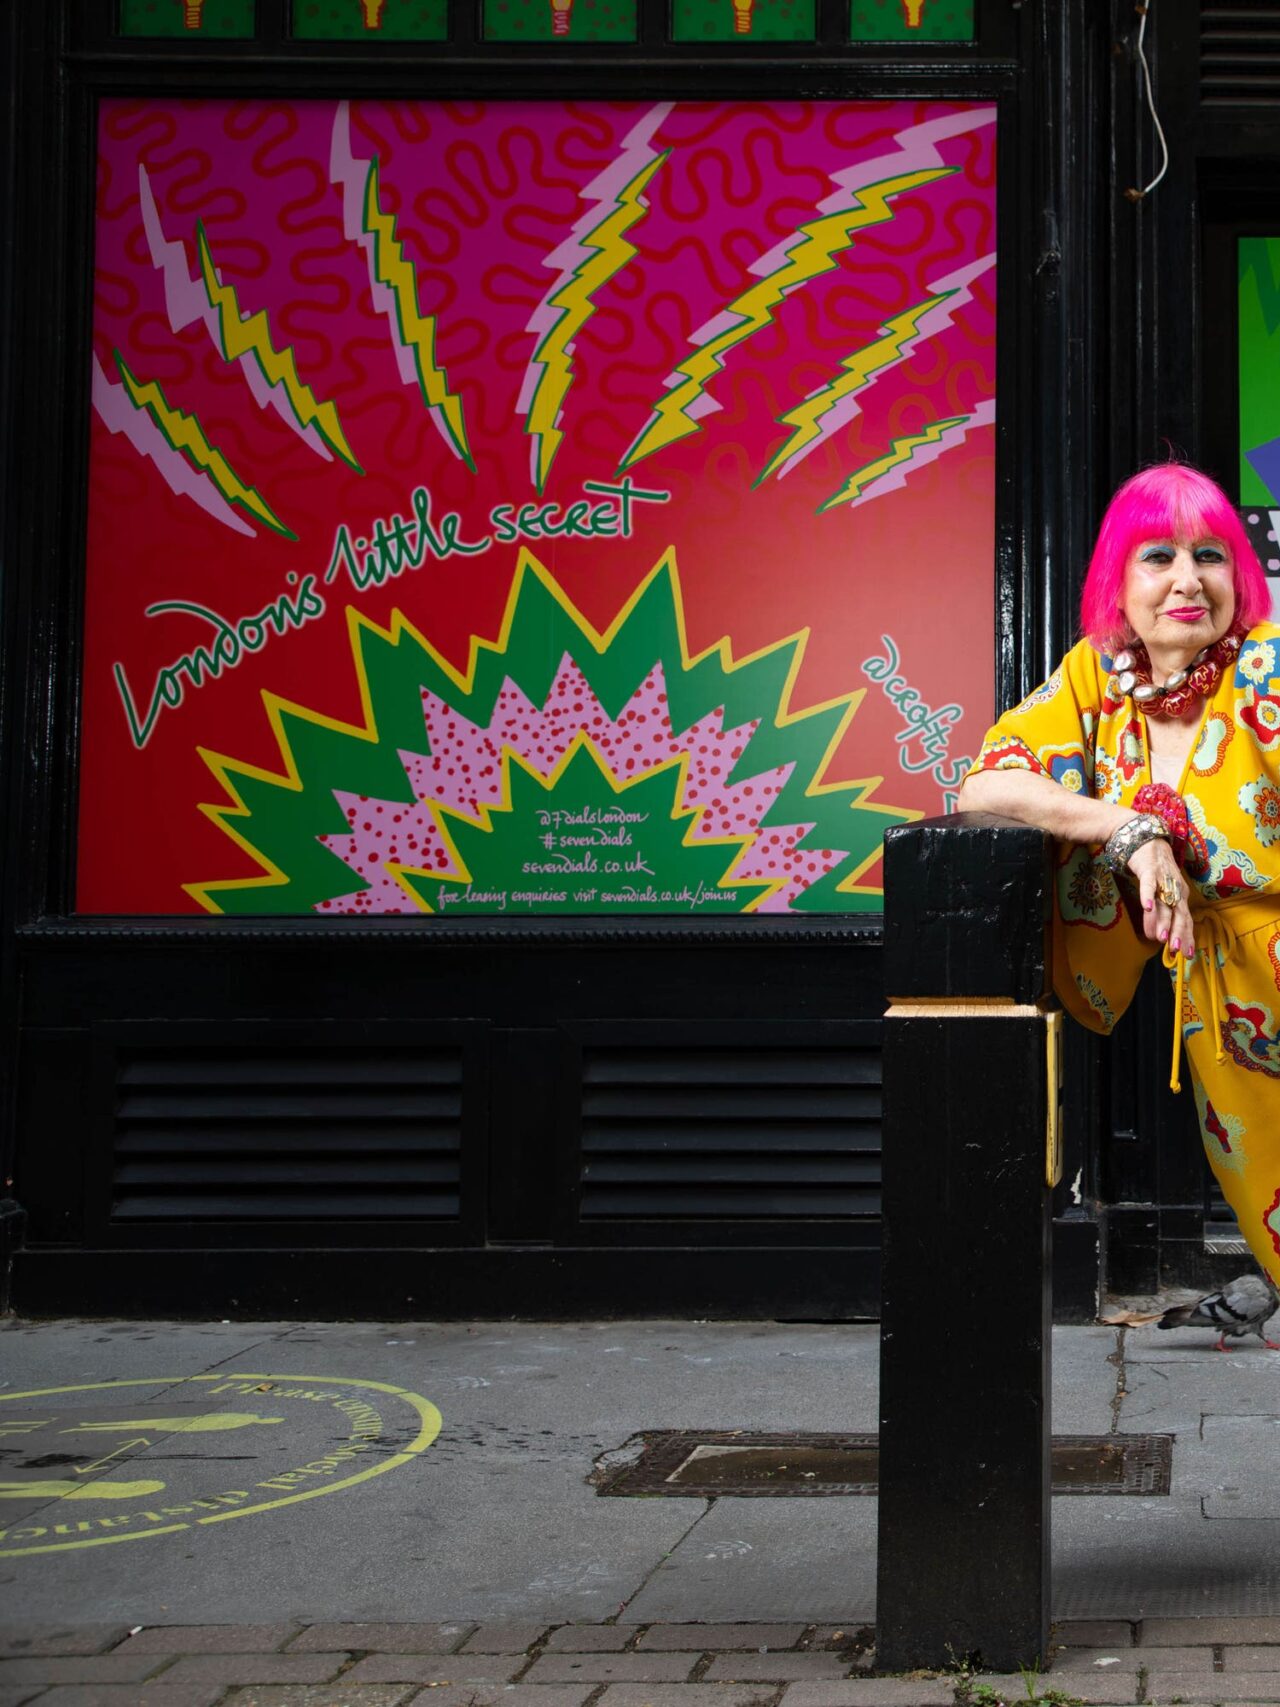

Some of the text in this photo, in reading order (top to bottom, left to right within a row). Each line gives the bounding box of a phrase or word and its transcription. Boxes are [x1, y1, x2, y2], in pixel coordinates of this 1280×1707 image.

[113, 573, 327, 750] London's
[325, 486, 492, 592] little
[521, 850, 656, 876] sevendials.co.uk
[437, 884, 462, 910] for
[462, 883, 507, 910] leasing
[572, 889, 597, 902] visit
[0, 1488, 250, 1541] distanc
